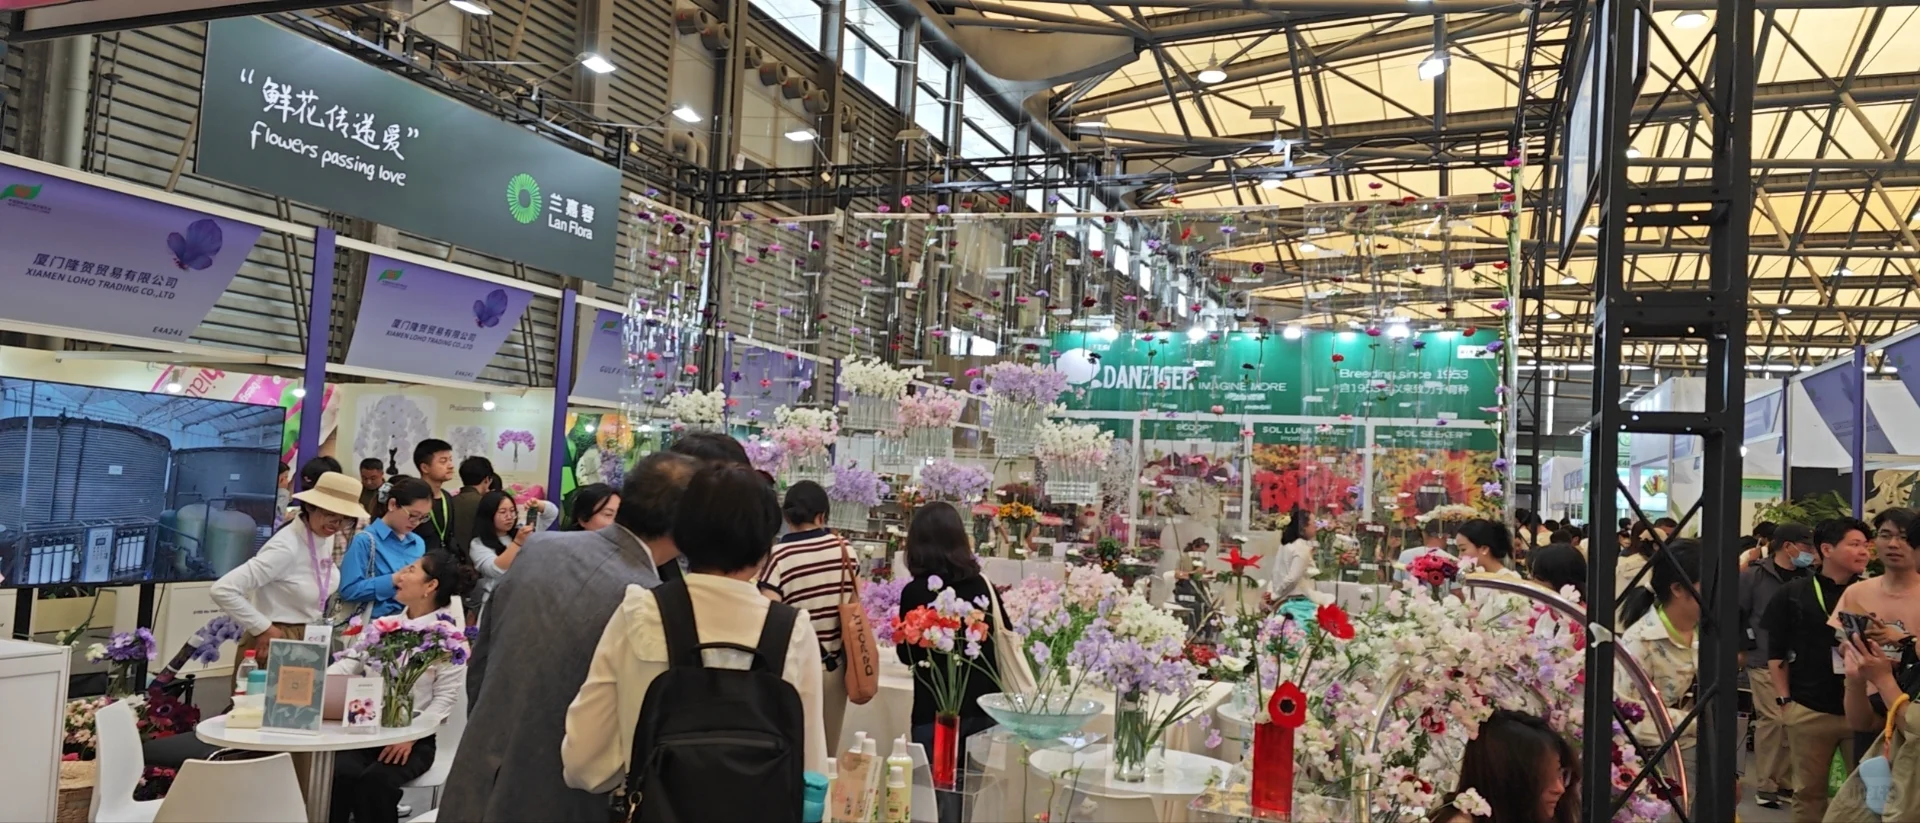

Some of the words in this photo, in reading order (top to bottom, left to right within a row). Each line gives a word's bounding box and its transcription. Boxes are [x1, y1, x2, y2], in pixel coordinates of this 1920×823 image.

[251, 121, 318, 158] flowers
[321, 150, 375, 181] passing
[378, 165, 406, 186] love
[548, 213, 567, 232] Lan
[568, 220, 593, 240] Flora
[33, 253, 178, 289] 厦门隆贺贸易有限公司
[26, 268, 66, 283] XIAMEN
[67, 274, 96, 287] LOHO
[97, 280, 139, 294] TRADING
[140, 287, 176, 300] CO.,LTD
[152, 326, 183, 337] E4A241
[385, 330, 408, 340] XIAMEN
[409, 334, 427, 343] LOHO
[427, 337, 451, 347] TRADING
[391, 319, 477, 342] 厦门隆贺贸易有限公司
[1103, 365, 1196, 390] DANZIGER
[1340, 368, 1395, 383] Breeding
[1397, 370, 1432, 380] since
[1437, 369, 1469, 380] 1953
[1198, 381, 1247, 392] IMAGINE
[1250, 382, 1287, 392] MORE
[1262, 426, 1282, 434] SOL
[1396, 430, 1418, 438] SOL
